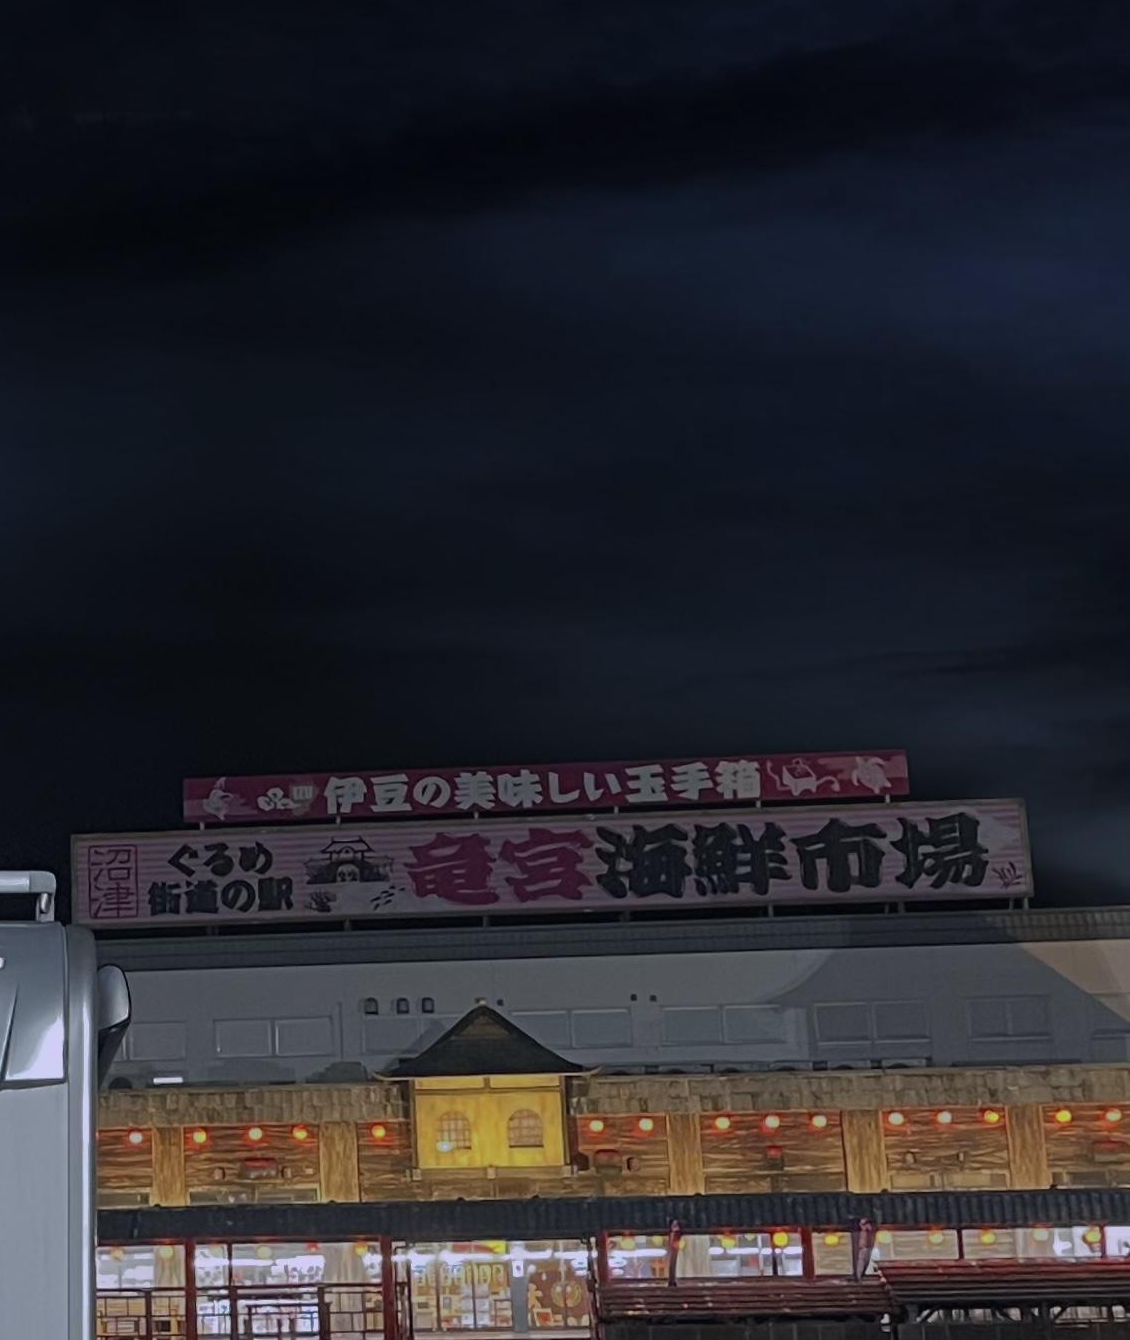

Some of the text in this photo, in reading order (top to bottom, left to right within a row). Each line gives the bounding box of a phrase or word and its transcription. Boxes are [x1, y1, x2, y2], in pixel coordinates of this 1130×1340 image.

[324, 759, 761, 814] 伊豆の美味しい玉手箱
[91, 847, 135, 918] 沼津
[168, 841, 273, 877] ぐるめ
[147, 876, 294, 916] 街道の駅
